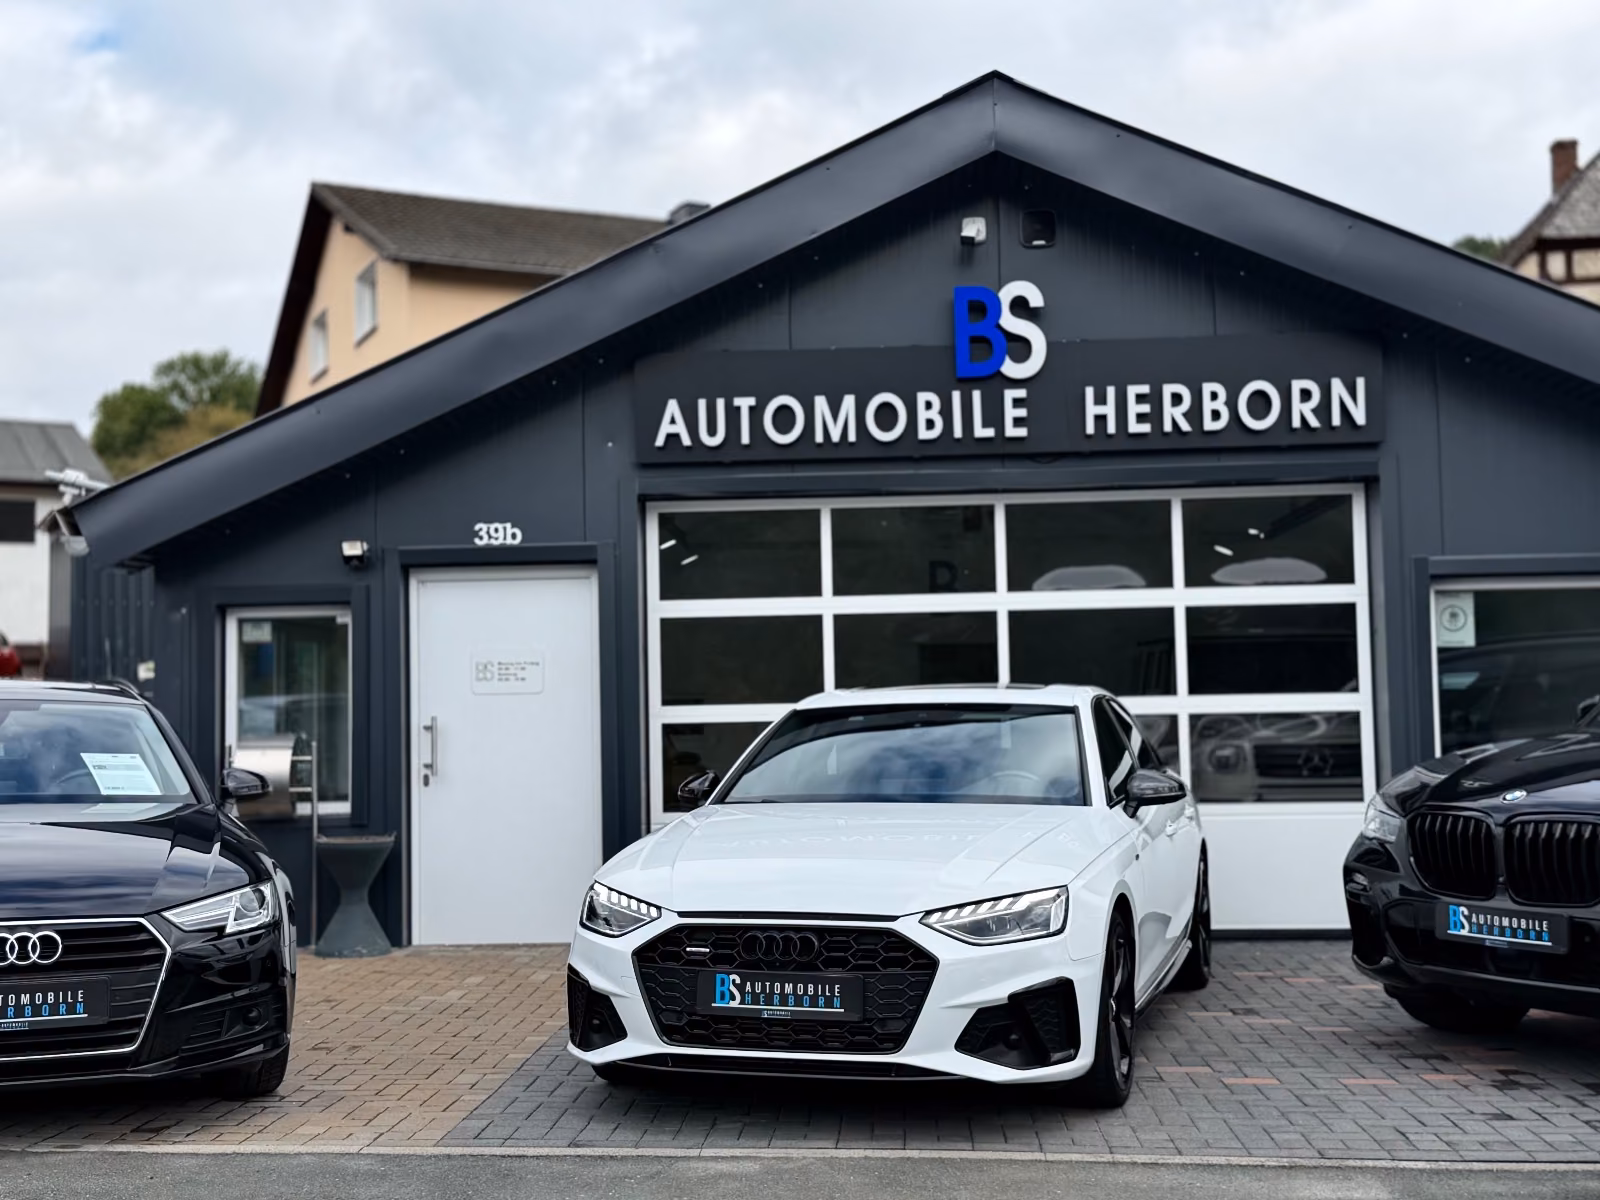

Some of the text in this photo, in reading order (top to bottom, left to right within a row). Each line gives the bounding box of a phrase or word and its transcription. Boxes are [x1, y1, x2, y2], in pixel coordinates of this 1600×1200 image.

[953, 280, 1048, 379] BS
[653, 376, 1368, 448] AUTOMOBILE HERBORN
[473, 522, 522, 546] 39b
[1448, 905, 1549, 933] BS AUTOMOBILE
[716, 974, 841, 1005] BS AUTOMOBILE
[745, 994, 841, 1008] HERBORN
